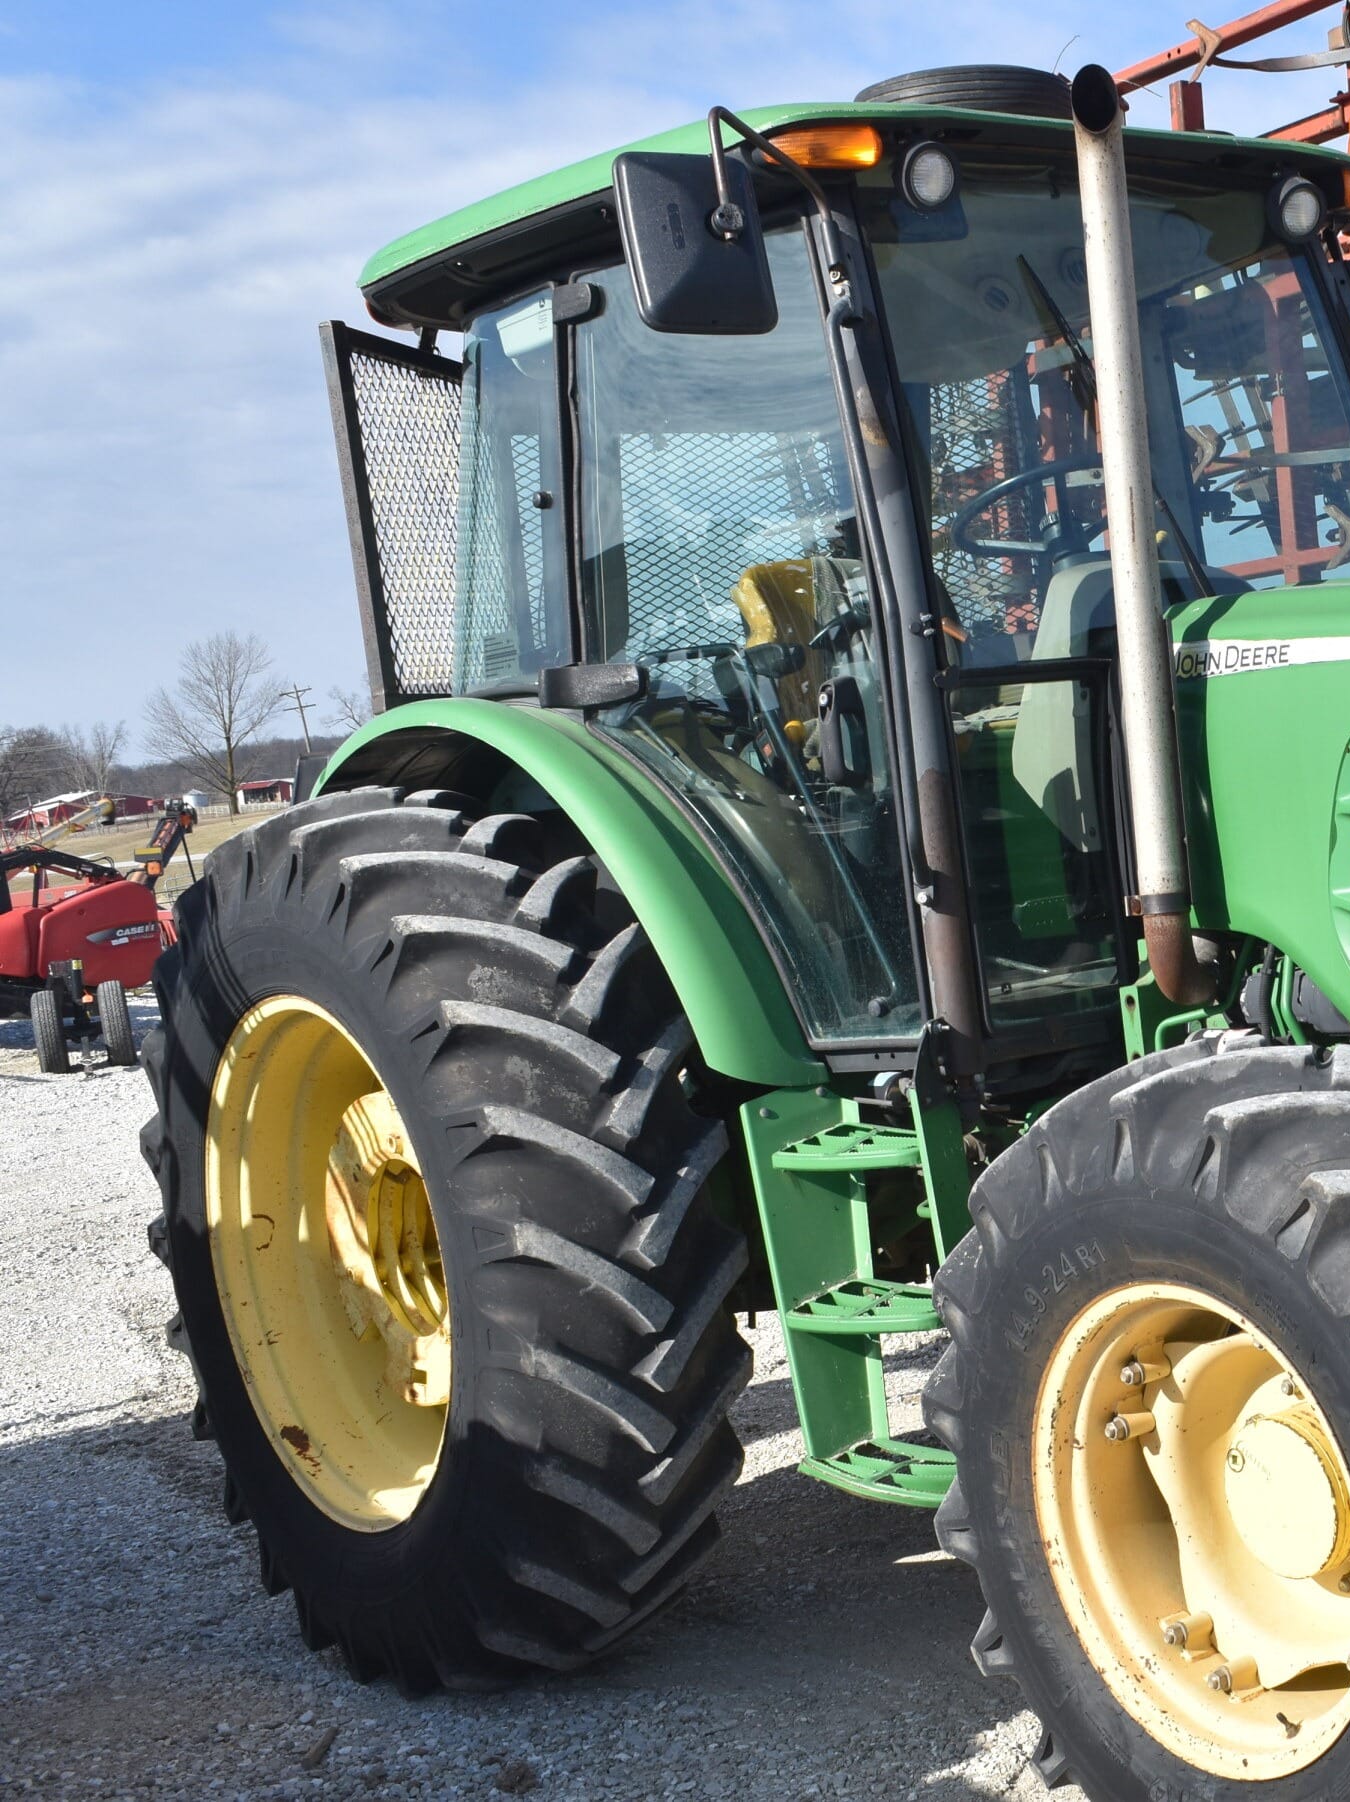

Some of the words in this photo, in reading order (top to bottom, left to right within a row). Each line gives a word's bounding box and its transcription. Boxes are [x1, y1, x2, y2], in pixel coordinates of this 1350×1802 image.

[1175, 650, 1222, 675] JOHN
[1223, 644, 1291, 669] DEERE
[116, 925, 145, 937] CASE
